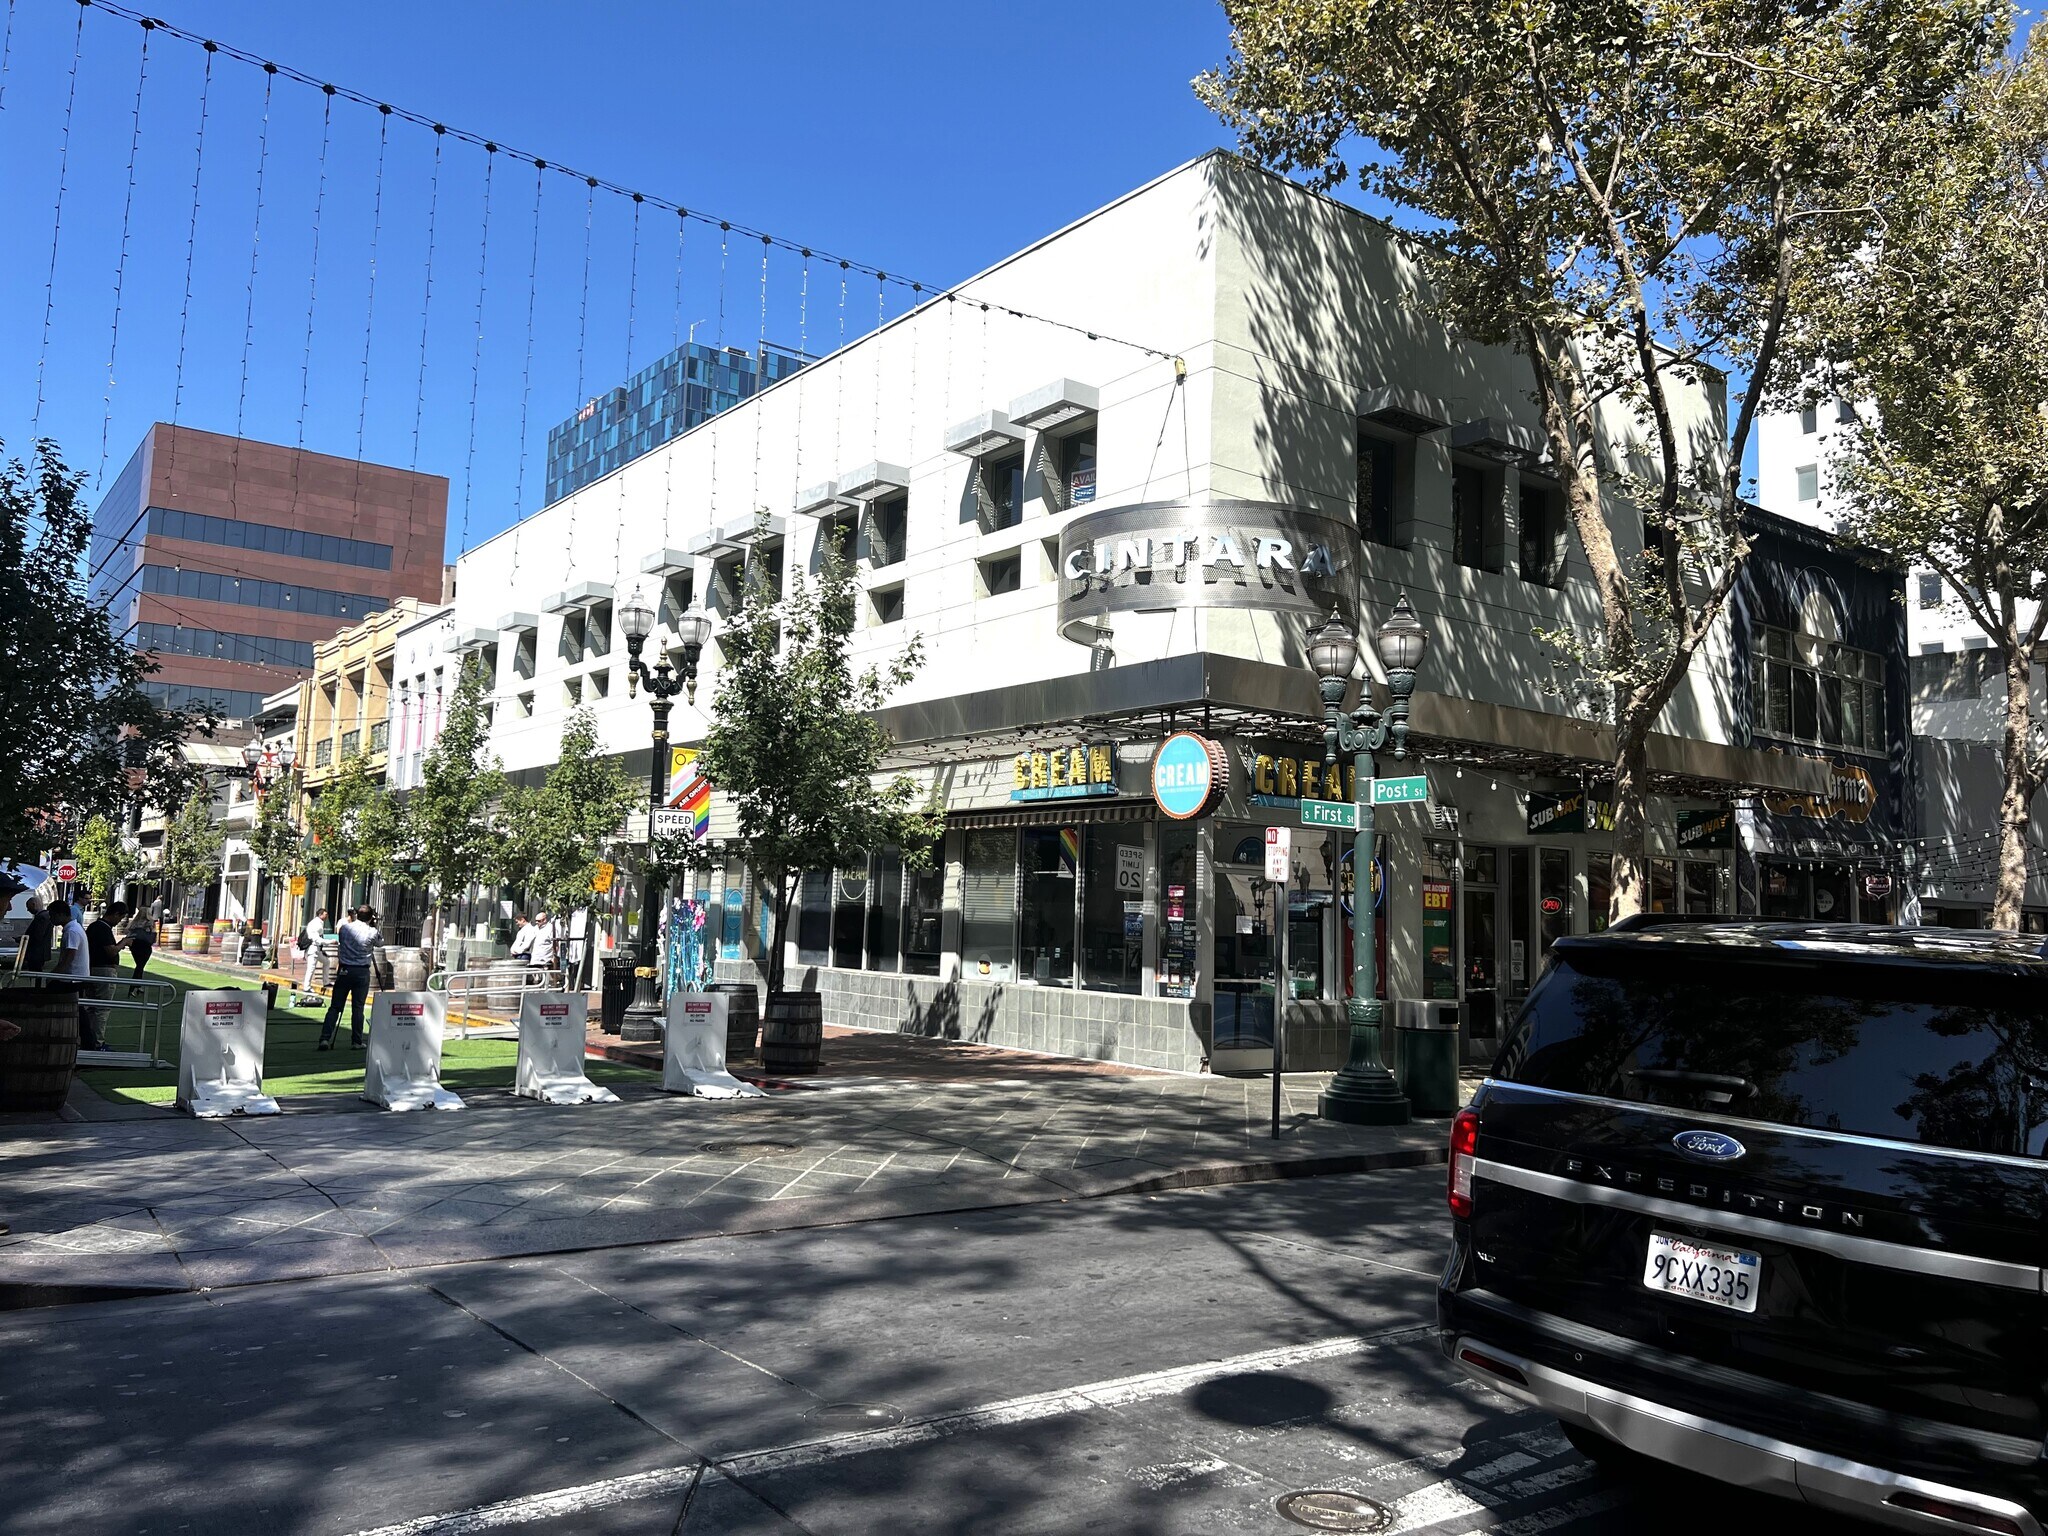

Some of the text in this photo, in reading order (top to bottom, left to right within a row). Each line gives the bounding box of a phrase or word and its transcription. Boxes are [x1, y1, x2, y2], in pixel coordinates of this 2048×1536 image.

[1064, 536, 1337, 580] CINTARA
[1014, 747, 1111, 789] CREAM
[1158, 761, 1207, 787] CREAM
[1377, 782, 1423, 799] Post St
[657, 814, 691, 824] SPEED
[1314, 805, 1342, 823] First
[1347, 814, 1354, 824] St
[1529, 794, 1583, 830] SUBWAY
[1267, 830, 1276, 842] NO
[1679, 812, 1730, 844] SUBWAY
[1268, 846, 1288, 857] STOPPING
[60, 869, 76, 877] STOP
[1272, 867, 1283, 875] TIME
[1425, 893, 1448, 908] EBT
[1542, 899, 1560, 911] OPEN
[1423, 919, 1447, 928] SUBWAY
[1687, 1135, 1727, 1153] Ford
[1566, 1159, 1864, 1227] EXPEDITION
[1671, 1240, 1740, 1265] California
[1652, 1254, 1750, 1300] 9CXX335
[1670, 1284, 1727, 1303] dmv.ca.gov
